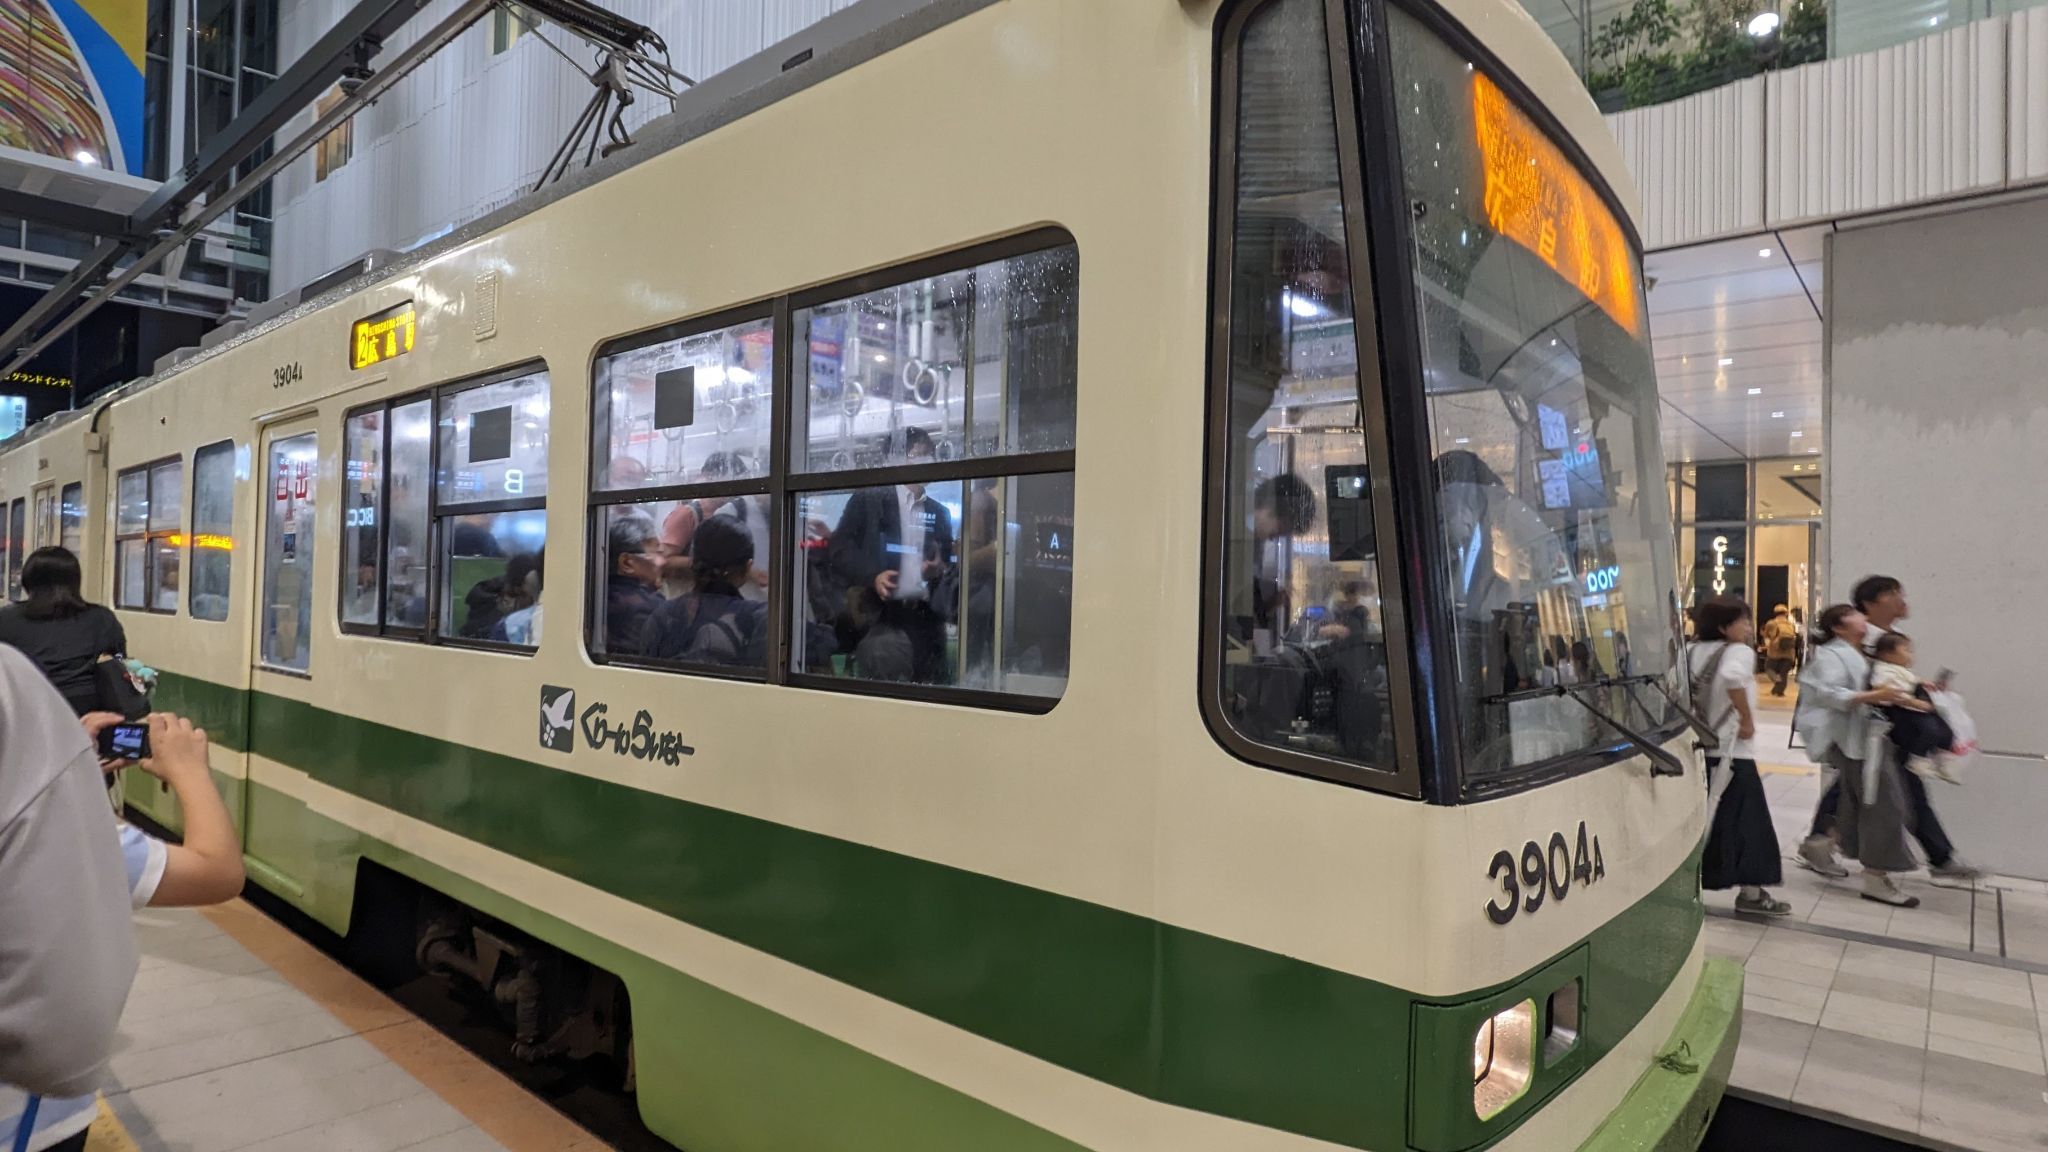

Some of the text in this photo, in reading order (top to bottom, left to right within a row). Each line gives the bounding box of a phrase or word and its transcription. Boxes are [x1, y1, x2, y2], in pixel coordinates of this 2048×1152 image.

[273, 361, 303, 389] 3904A
[1713, 535, 1728, 595] CITY
[1484, 820, 1606, 926] 3904A
